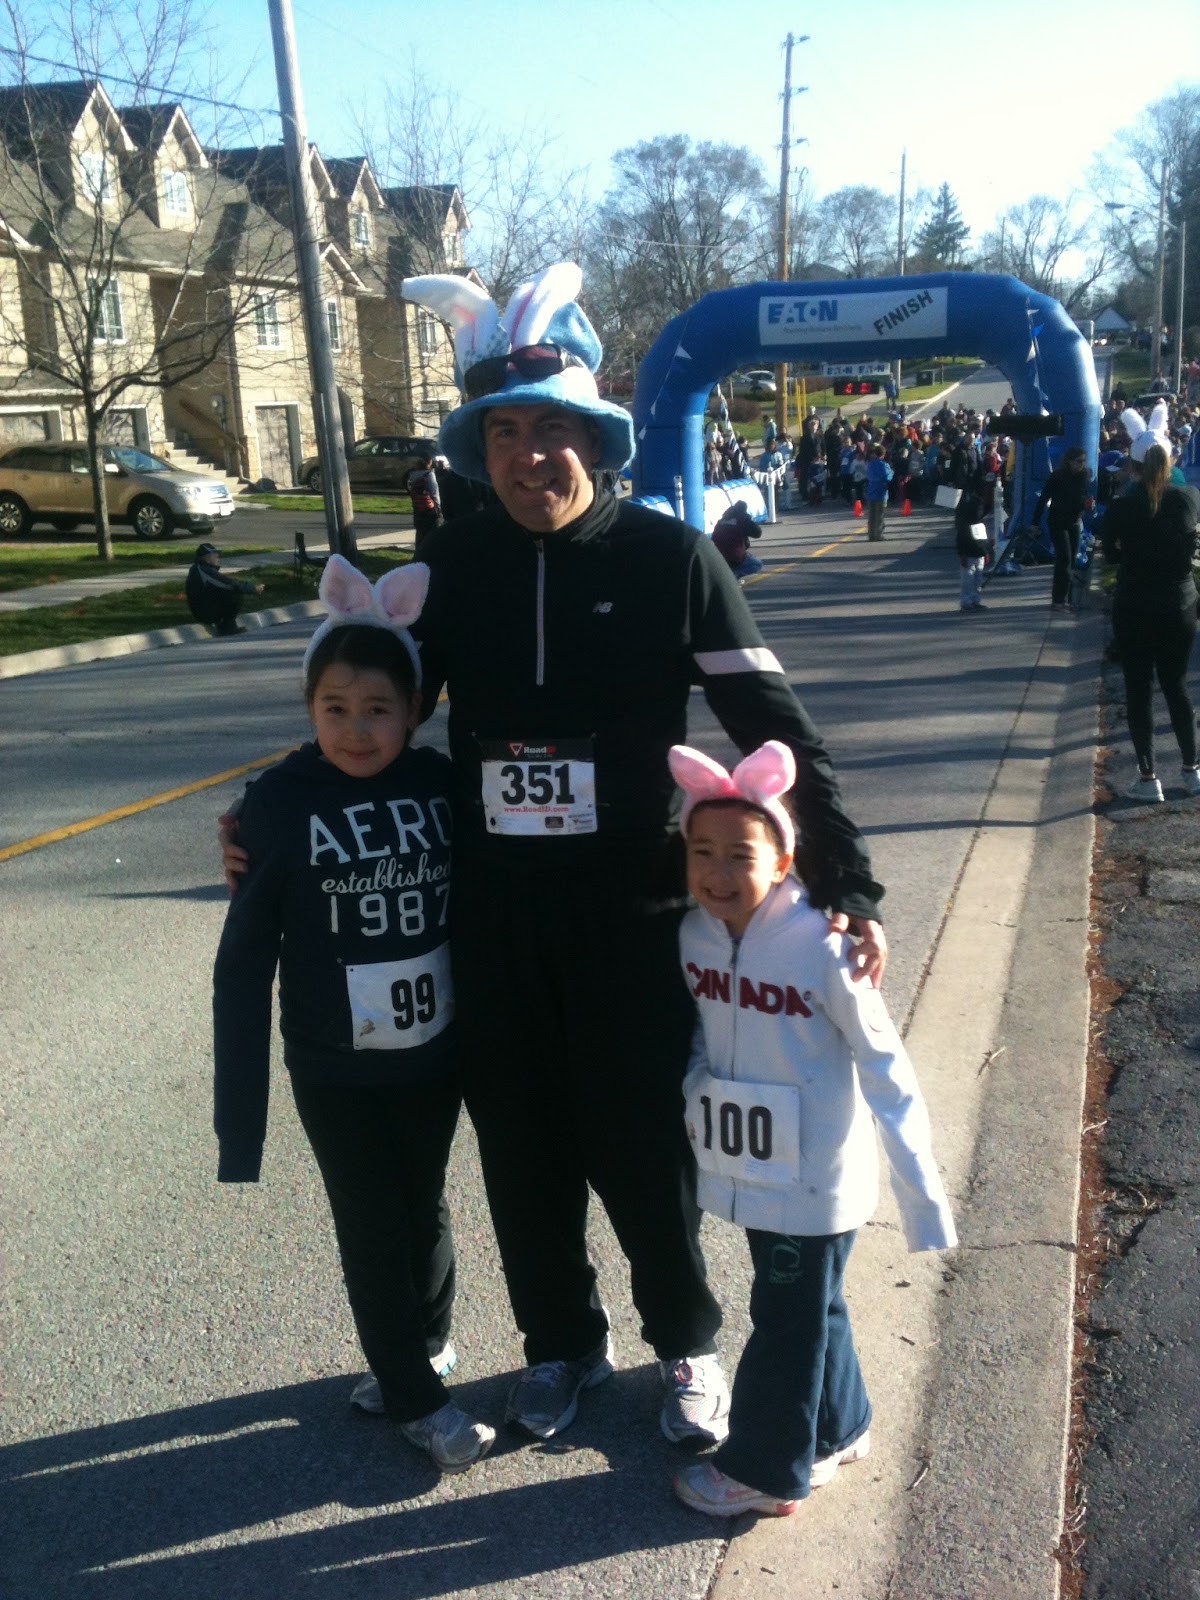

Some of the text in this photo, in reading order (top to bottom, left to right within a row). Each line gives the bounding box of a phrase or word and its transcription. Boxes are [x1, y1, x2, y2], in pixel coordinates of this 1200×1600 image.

[768, 300, 838, 324] EATON
[873, 290, 933, 336] FINISH
[501, 763, 575, 805] 351
[309, 797, 454, 866] AERO
[330, 882, 452, 937] 1987
[390, 973, 436, 1030] 99
[700, 1095, 773, 1161] 100
